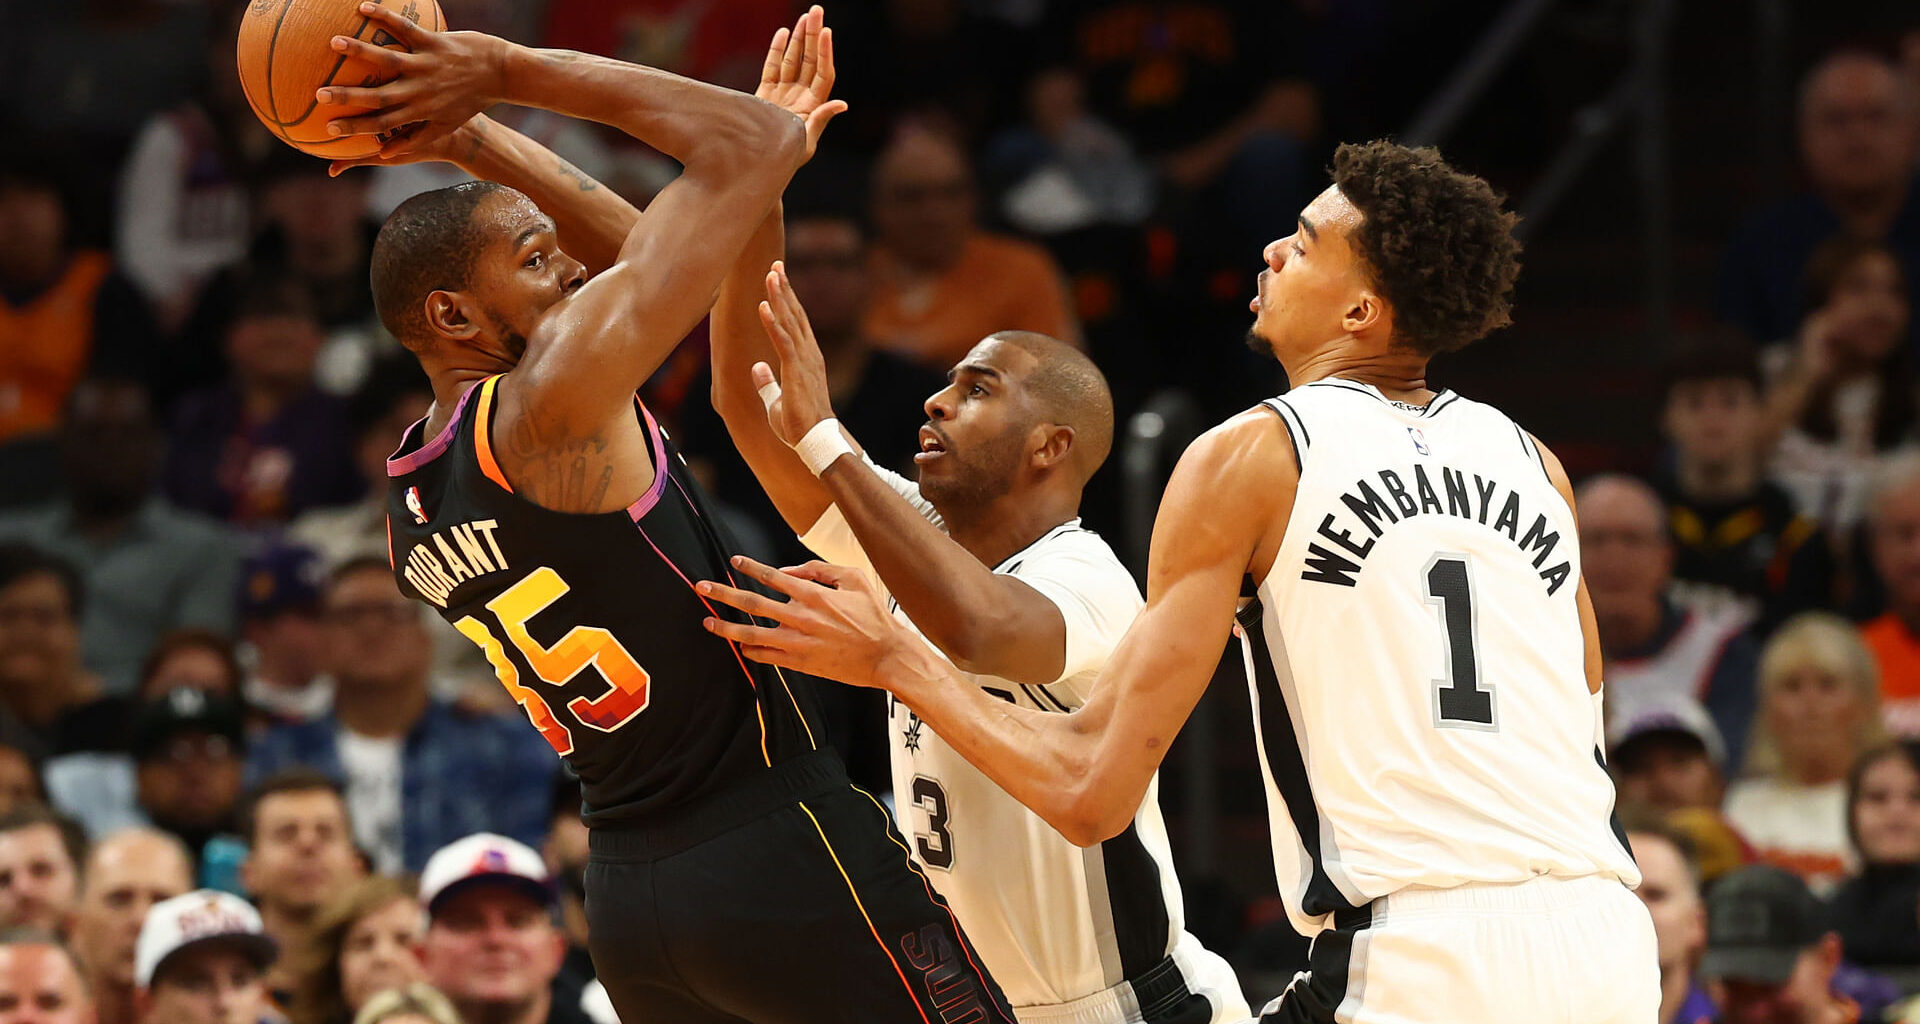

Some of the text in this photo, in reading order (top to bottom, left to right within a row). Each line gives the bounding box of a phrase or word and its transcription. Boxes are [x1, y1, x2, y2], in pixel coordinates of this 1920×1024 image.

[404, 518, 509, 608] DURANT
[1301, 464, 1571, 597] WEMBANYAMA
[1420, 551, 1500, 733] 1
[910, 773, 956, 873] 3
